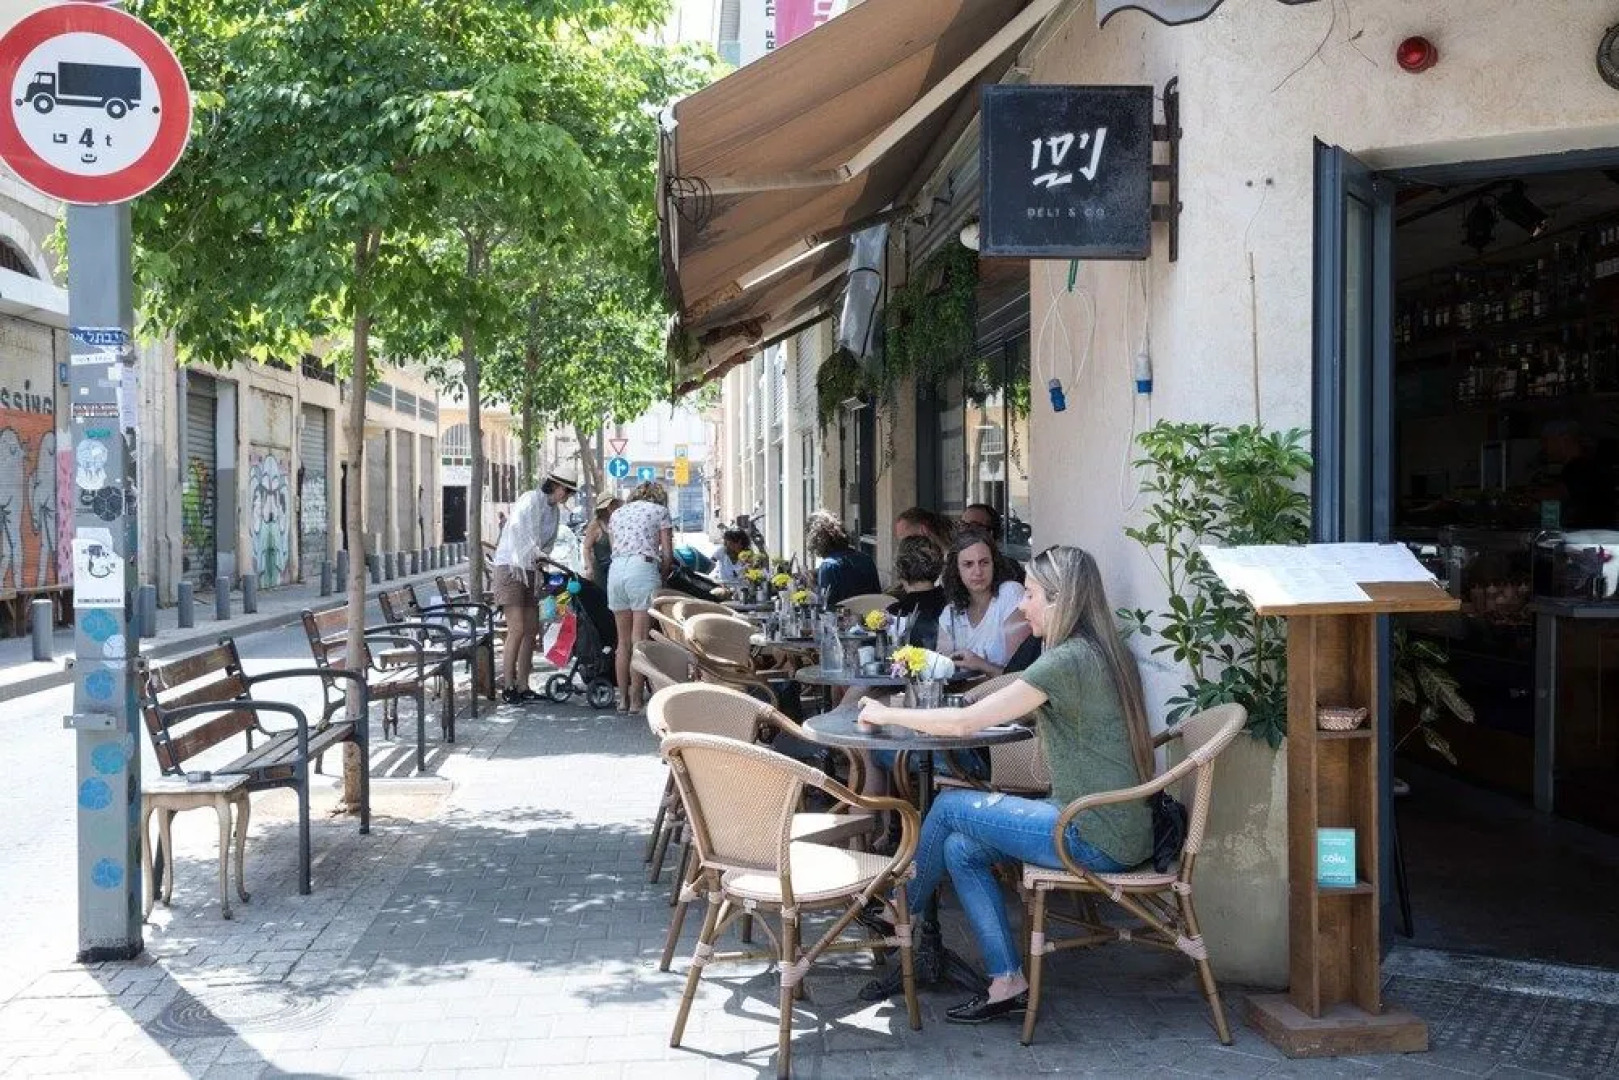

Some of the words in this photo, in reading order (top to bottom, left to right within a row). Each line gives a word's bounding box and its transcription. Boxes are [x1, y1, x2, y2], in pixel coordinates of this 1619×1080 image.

[79, 128, 94, 148] 4
[105, 134, 112, 147] t
[1027, 207, 1060, 218] DELI
[1068, 207, 1076, 218] &
[1084, 208, 1105, 218] CO
